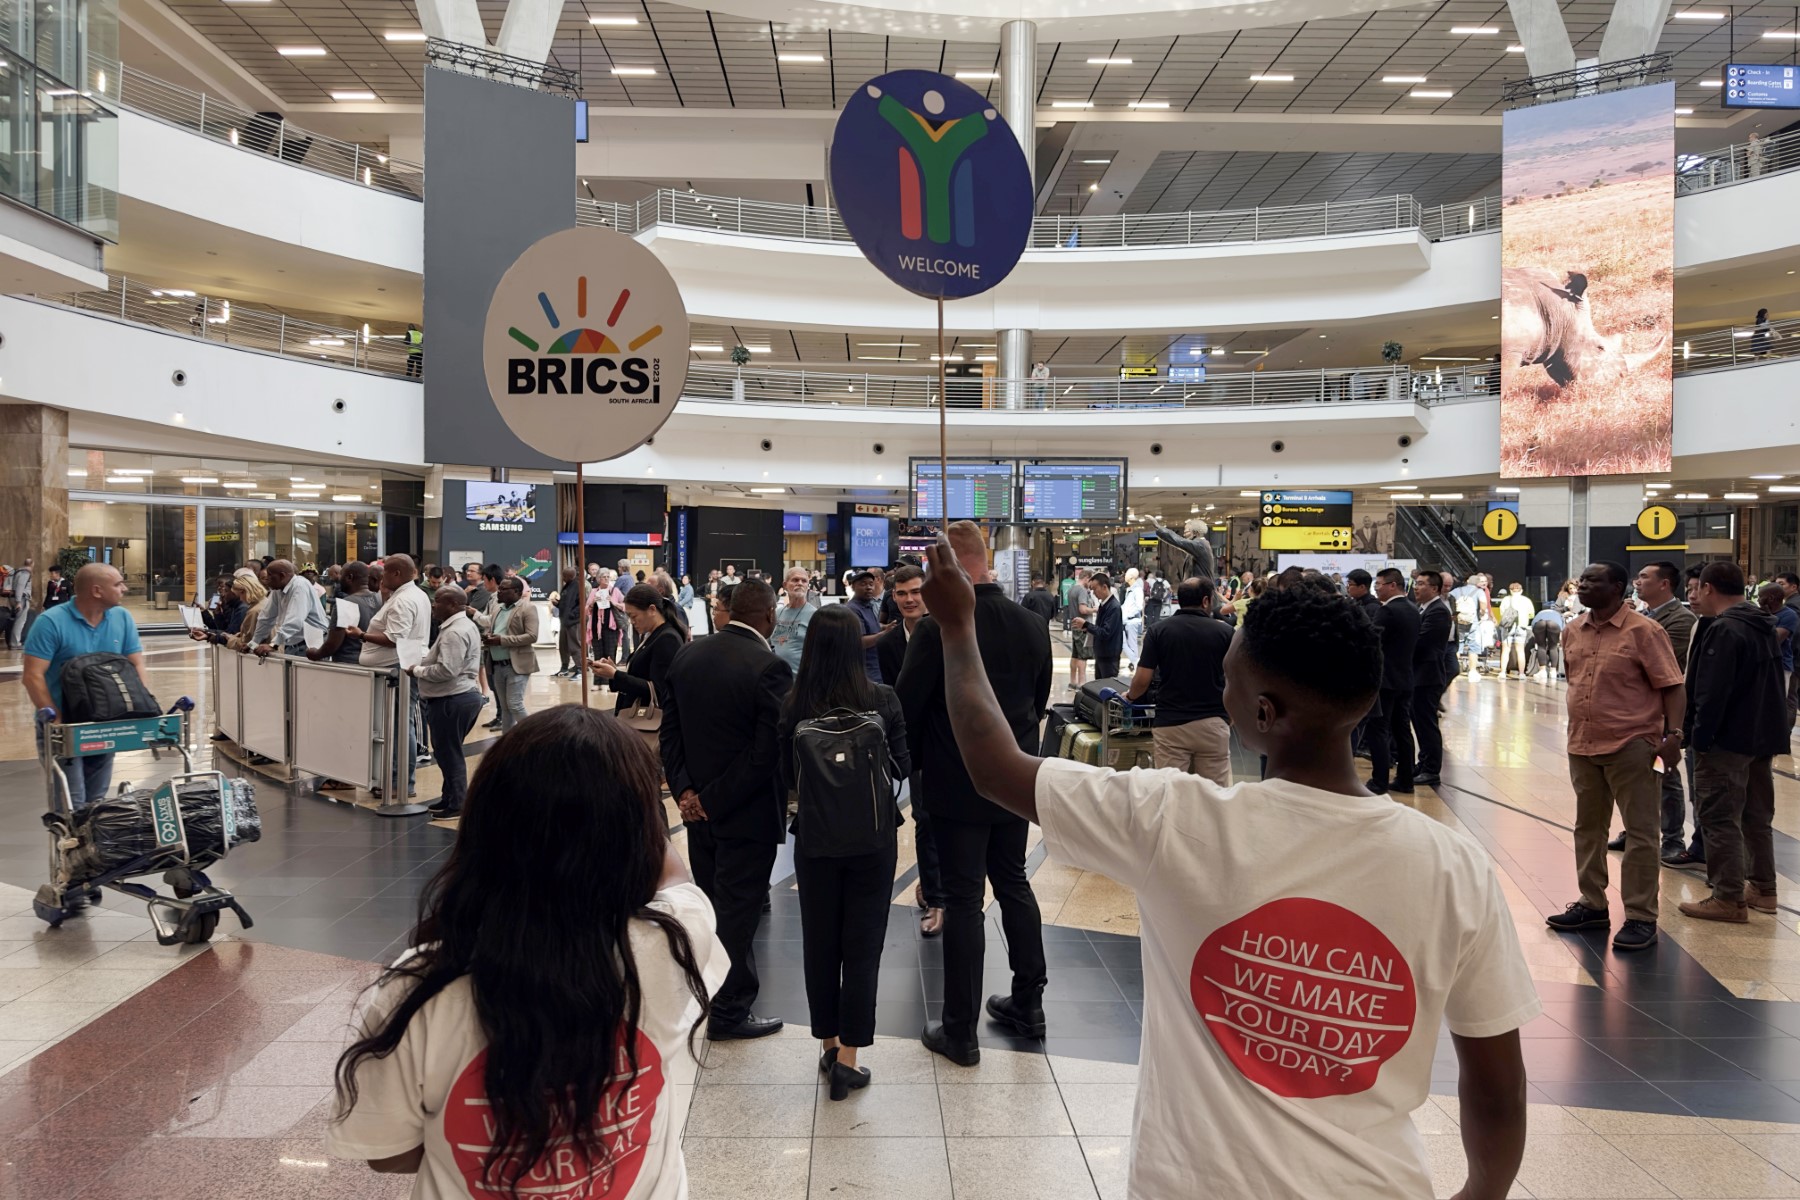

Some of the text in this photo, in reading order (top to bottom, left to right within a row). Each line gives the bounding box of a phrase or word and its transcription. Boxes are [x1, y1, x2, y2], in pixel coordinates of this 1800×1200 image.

[898, 254, 980, 279] WELCOME
[508, 357, 650, 395] BRICS
[480, 523, 523, 532] SAMSUNG
[1078, 557, 1103, 565] sunglass
[1240, 930, 1393, 982] HOW CAN
[1234, 962, 1387, 1020] WE MAKE
[1221, 991, 1386, 1055] YOUR DAY
[1239, 1033, 1353, 1082] TODAY?
